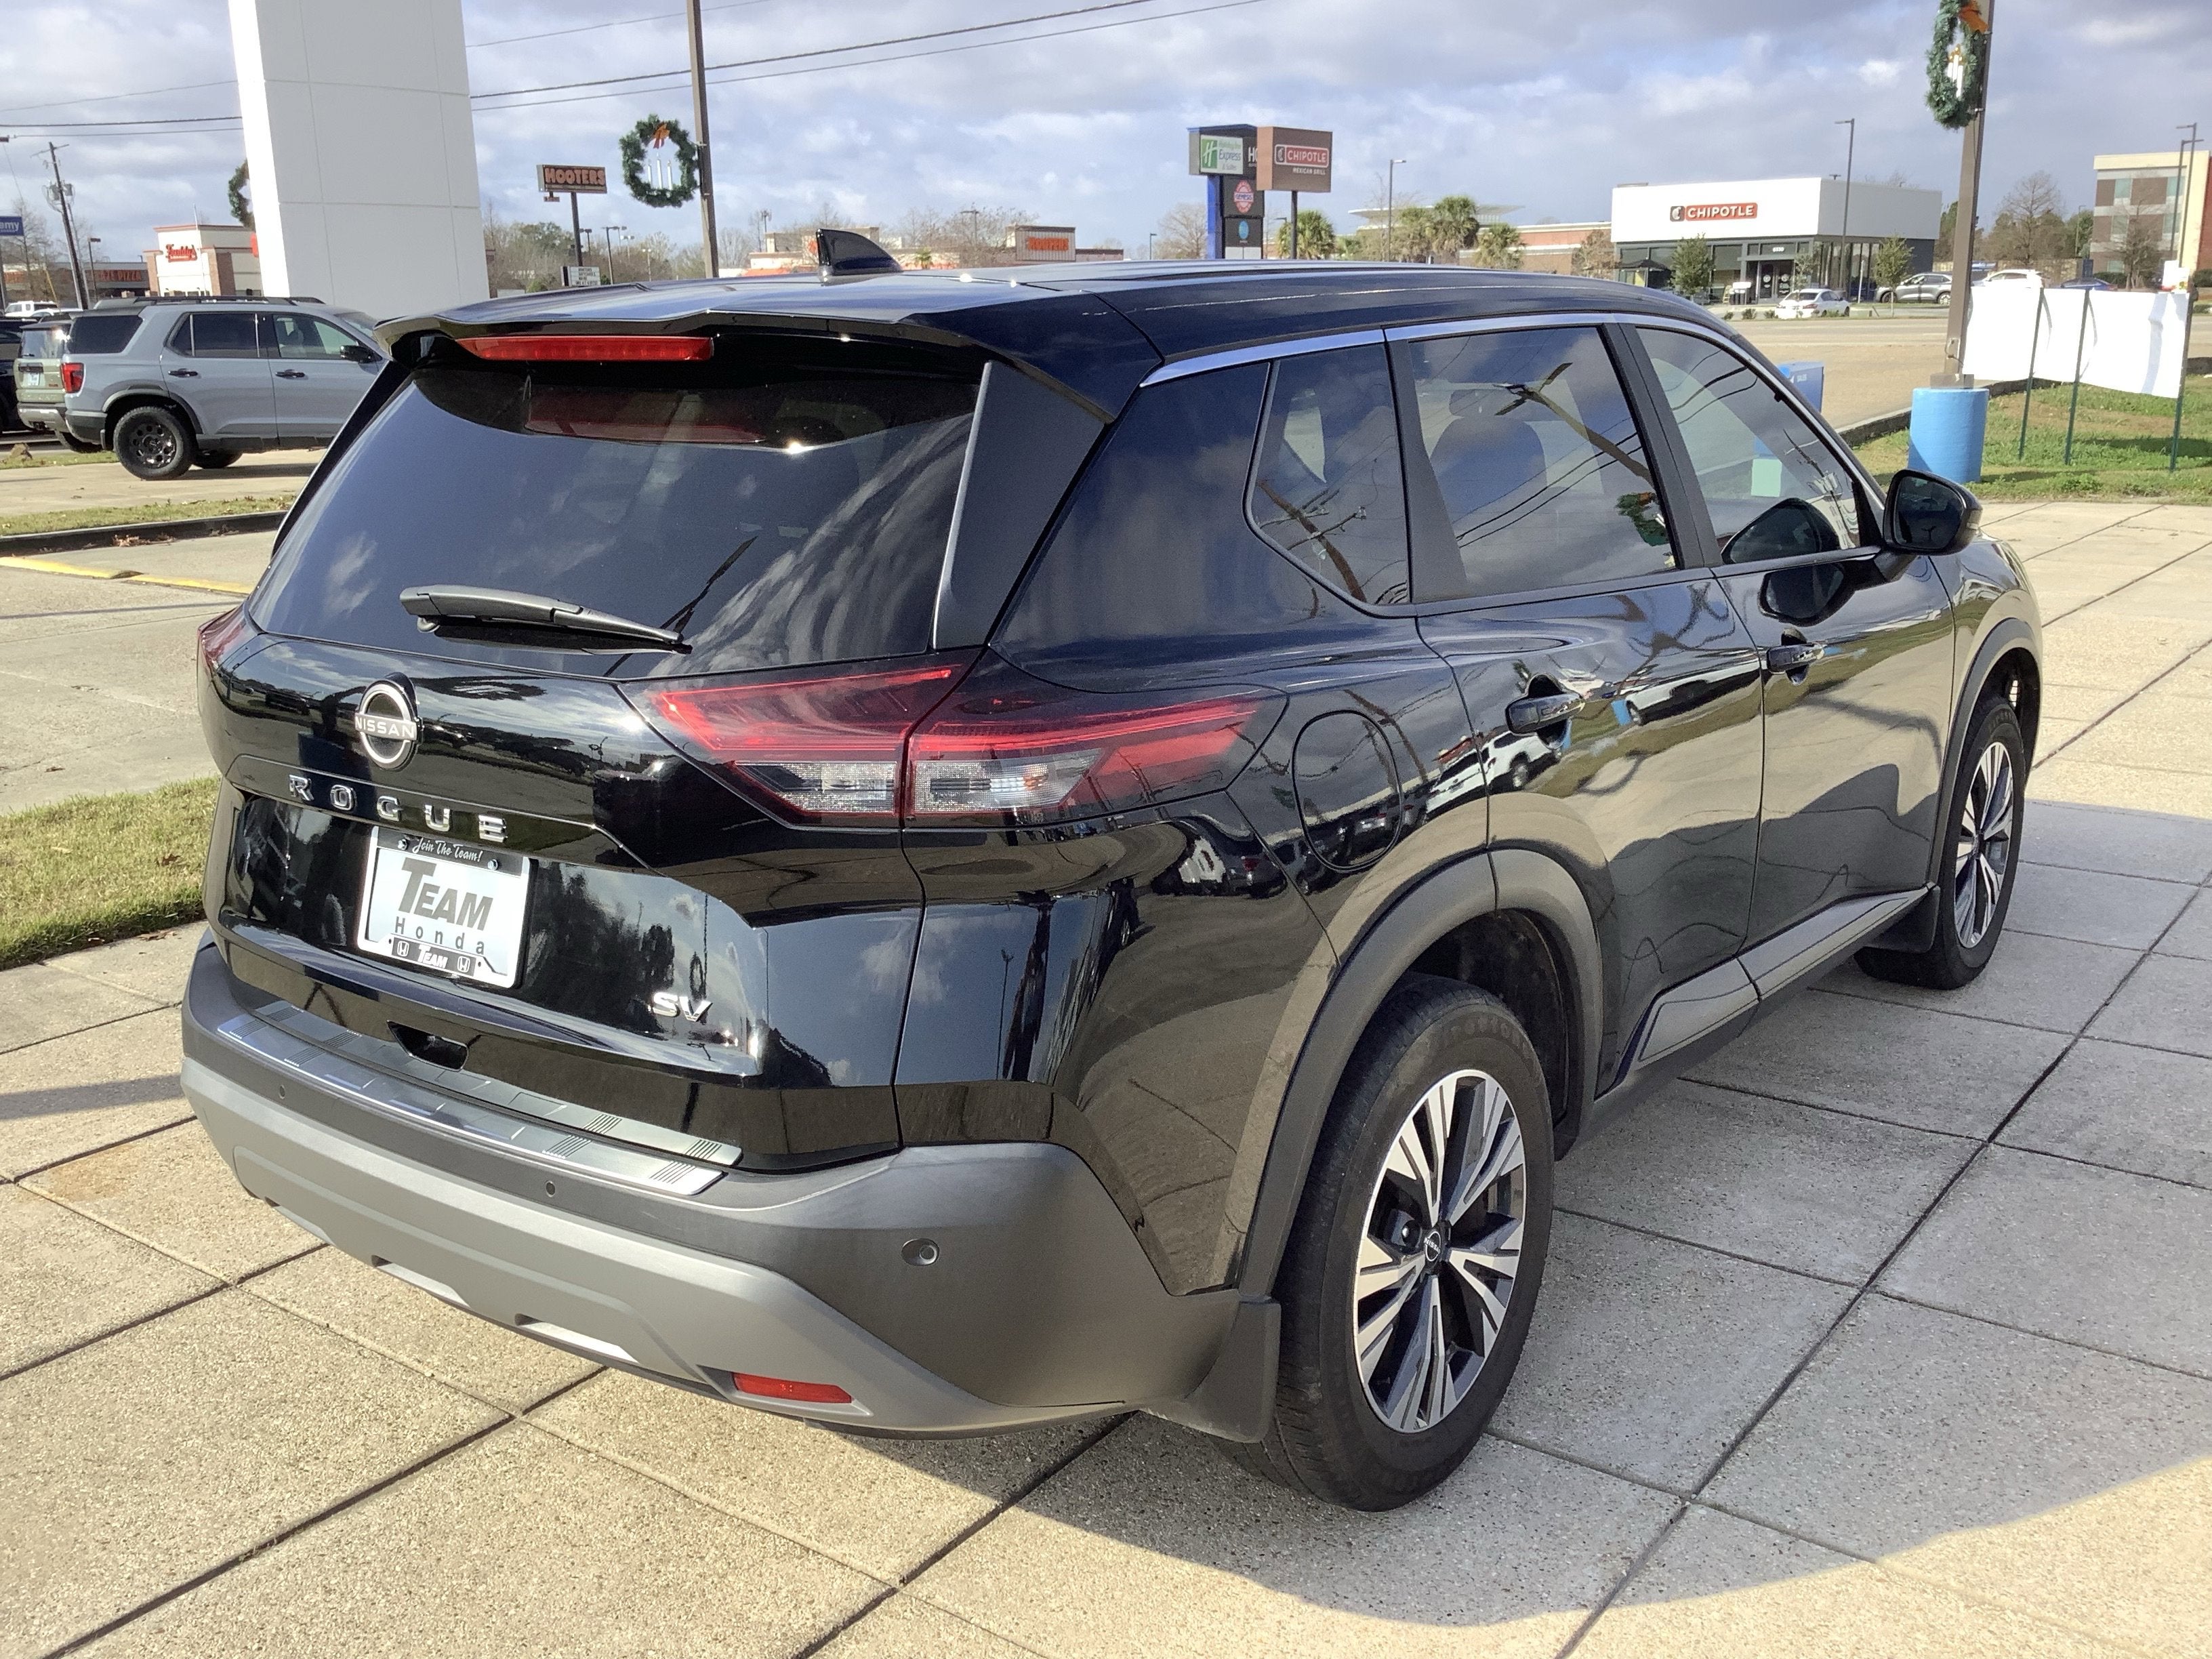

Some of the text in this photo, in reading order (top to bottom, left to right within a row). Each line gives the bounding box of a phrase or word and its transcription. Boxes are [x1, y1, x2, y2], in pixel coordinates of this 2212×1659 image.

[1219, 149, 1241, 162] Express
[1288, 150, 1326, 163] CHIPOTLE
[545, 167, 605, 185] HOOTERS
[1687, 205, 1754, 218] CHIPOTLE
[355, 716, 415, 739] NISSAN
[289, 774, 509, 843] ROGUE
[412, 838, 483, 862] Join The Team!
[398, 857, 493, 931] TEAM
[395, 916, 485, 955] Honda
[417, 944, 449, 968] TEAM
[653, 992, 712, 1022] SV
